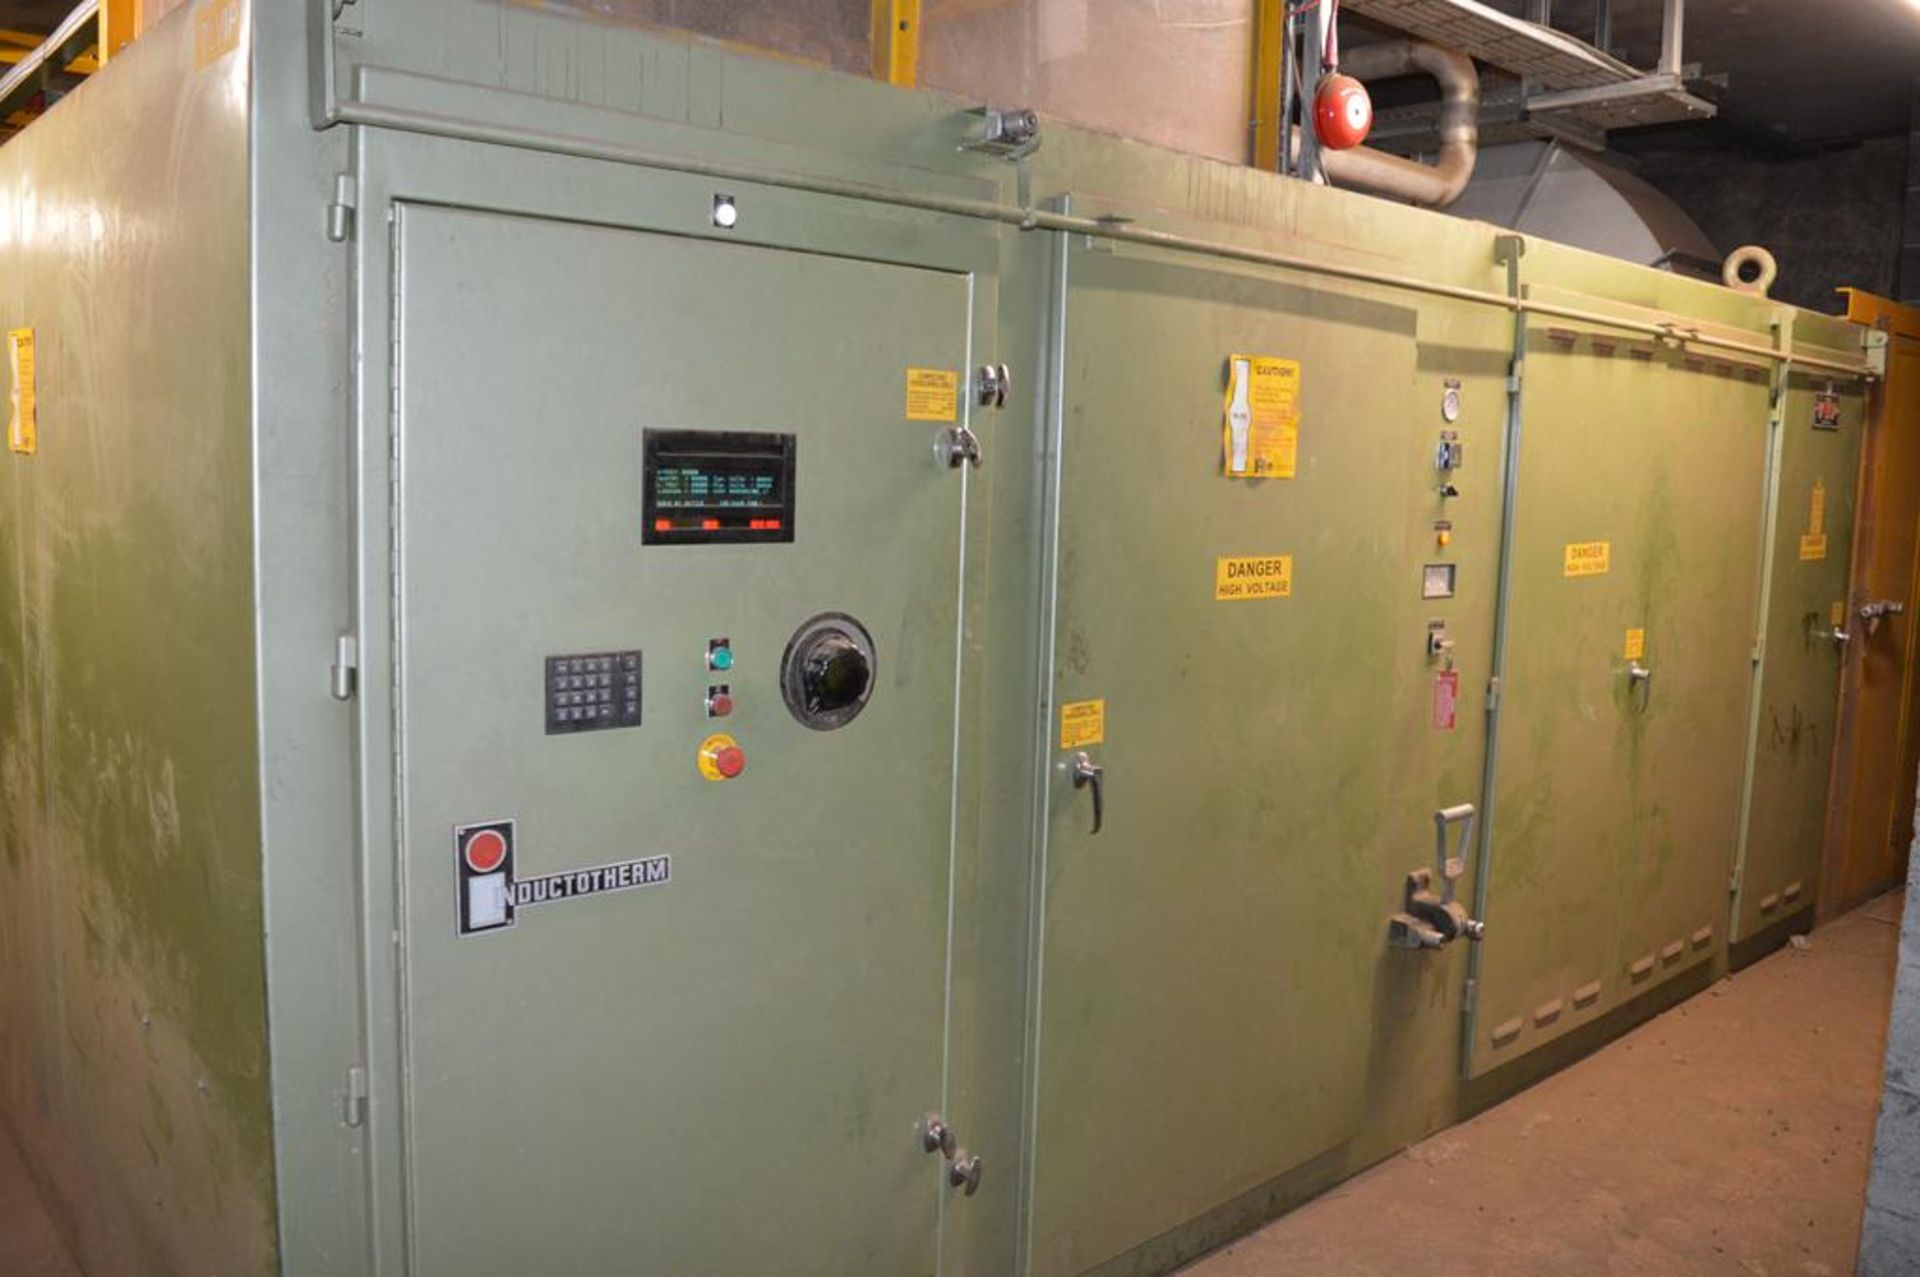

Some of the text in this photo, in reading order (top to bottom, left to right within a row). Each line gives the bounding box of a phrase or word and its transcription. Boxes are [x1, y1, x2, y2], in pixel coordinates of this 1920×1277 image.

[1227, 560, 1281, 578] DANGER
[1218, 580, 1289, 596] HIGH VOLTAGE
